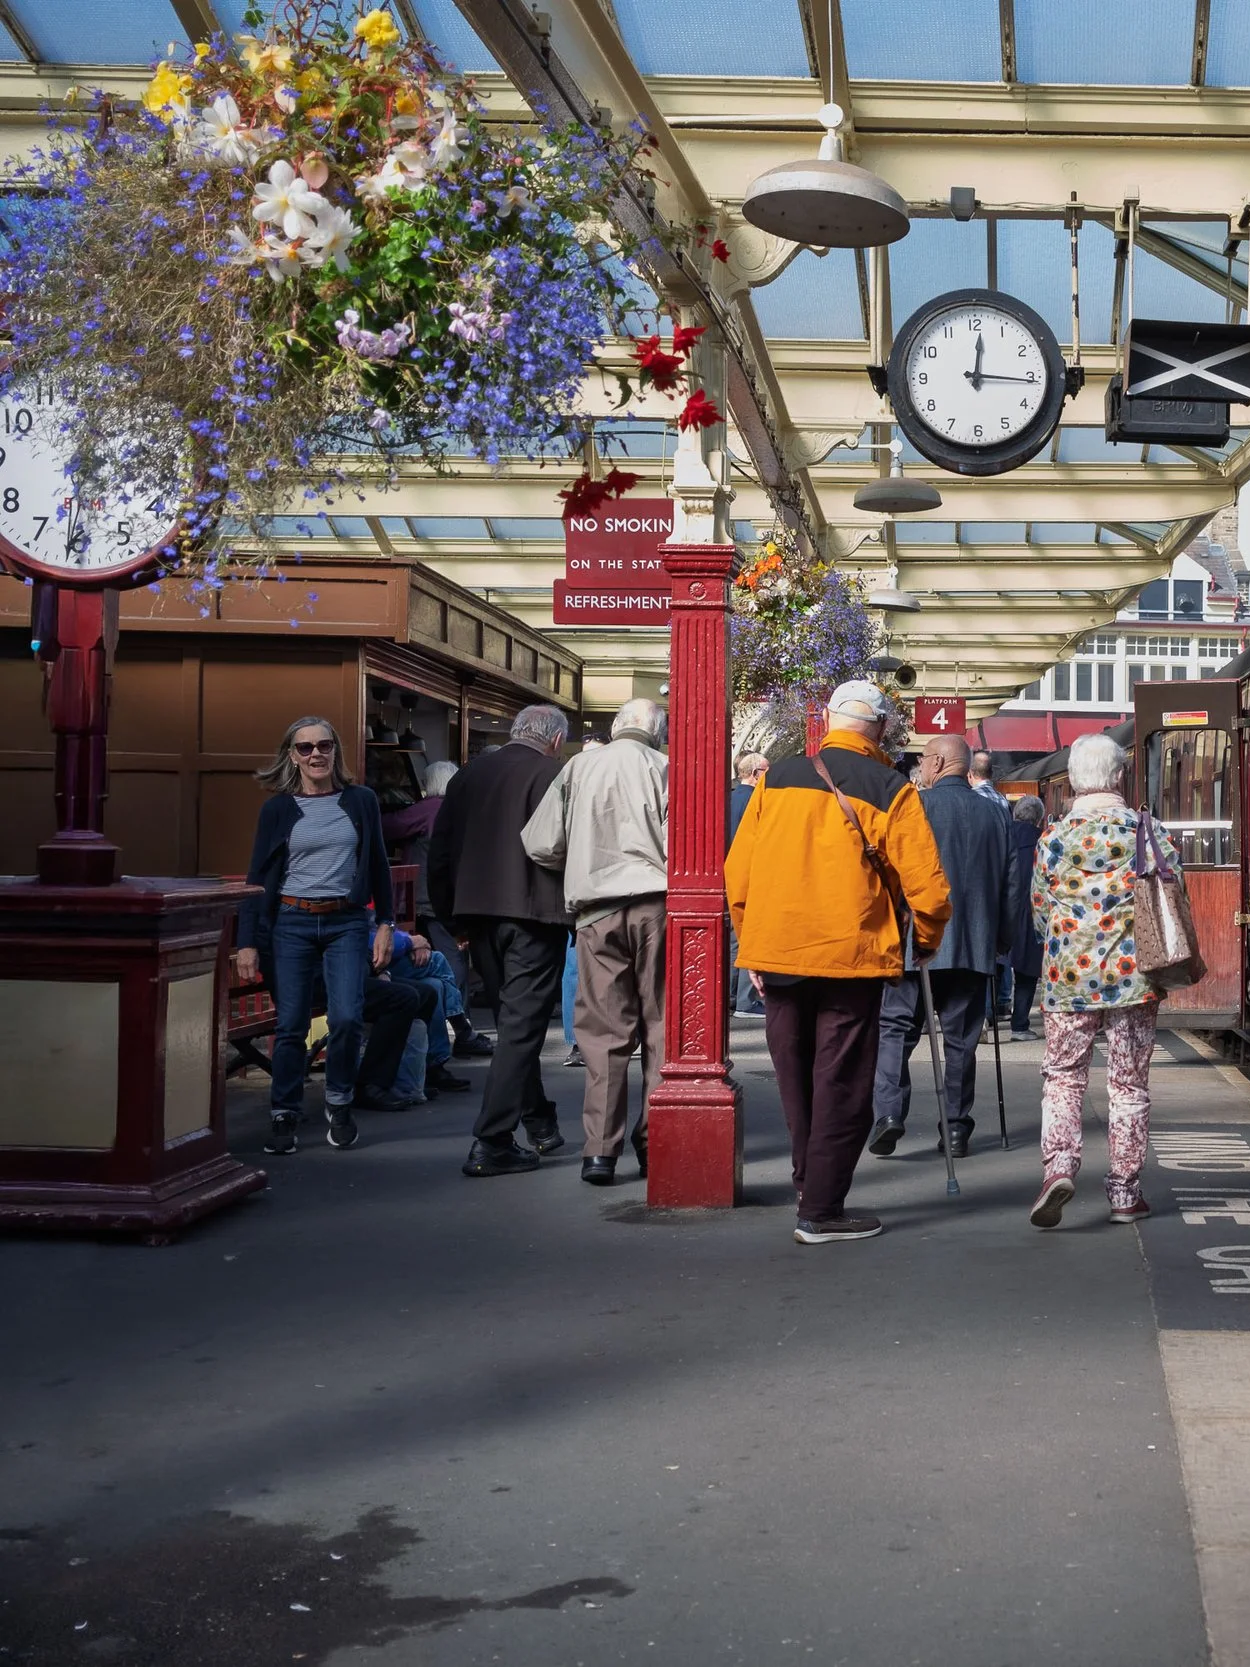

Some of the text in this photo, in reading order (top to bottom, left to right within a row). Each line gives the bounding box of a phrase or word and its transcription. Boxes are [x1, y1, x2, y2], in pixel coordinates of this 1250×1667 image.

[969, 319, 982, 331] 12
[944, 326, 953, 338] 11
[923, 346, 937, 358] 10
[1018, 345, 1027, 357] 2
[919, 373, 928, 385] 9
[1026, 371, 1035, 384] 3
[927, 399, 936, 411] 8
[1020, 398, 1028, 409] 4
[5, 408, 33, 434] 10
[947, 418, 956, 431] 7
[1001, 417, 1010, 430] 5
[974, 425, 983, 437] 6
[3, 487, 20, 513] 8
[32, 516, 49, 541] 7
[570, 518, 672, 533] NO SMOKIN
[117, 521, 131, 545] 5
[570, 560, 661, 569] ON THE STAT
[565, 595, 672, 609] REFRESHMENT
[932, 707, 949, 730] 4
